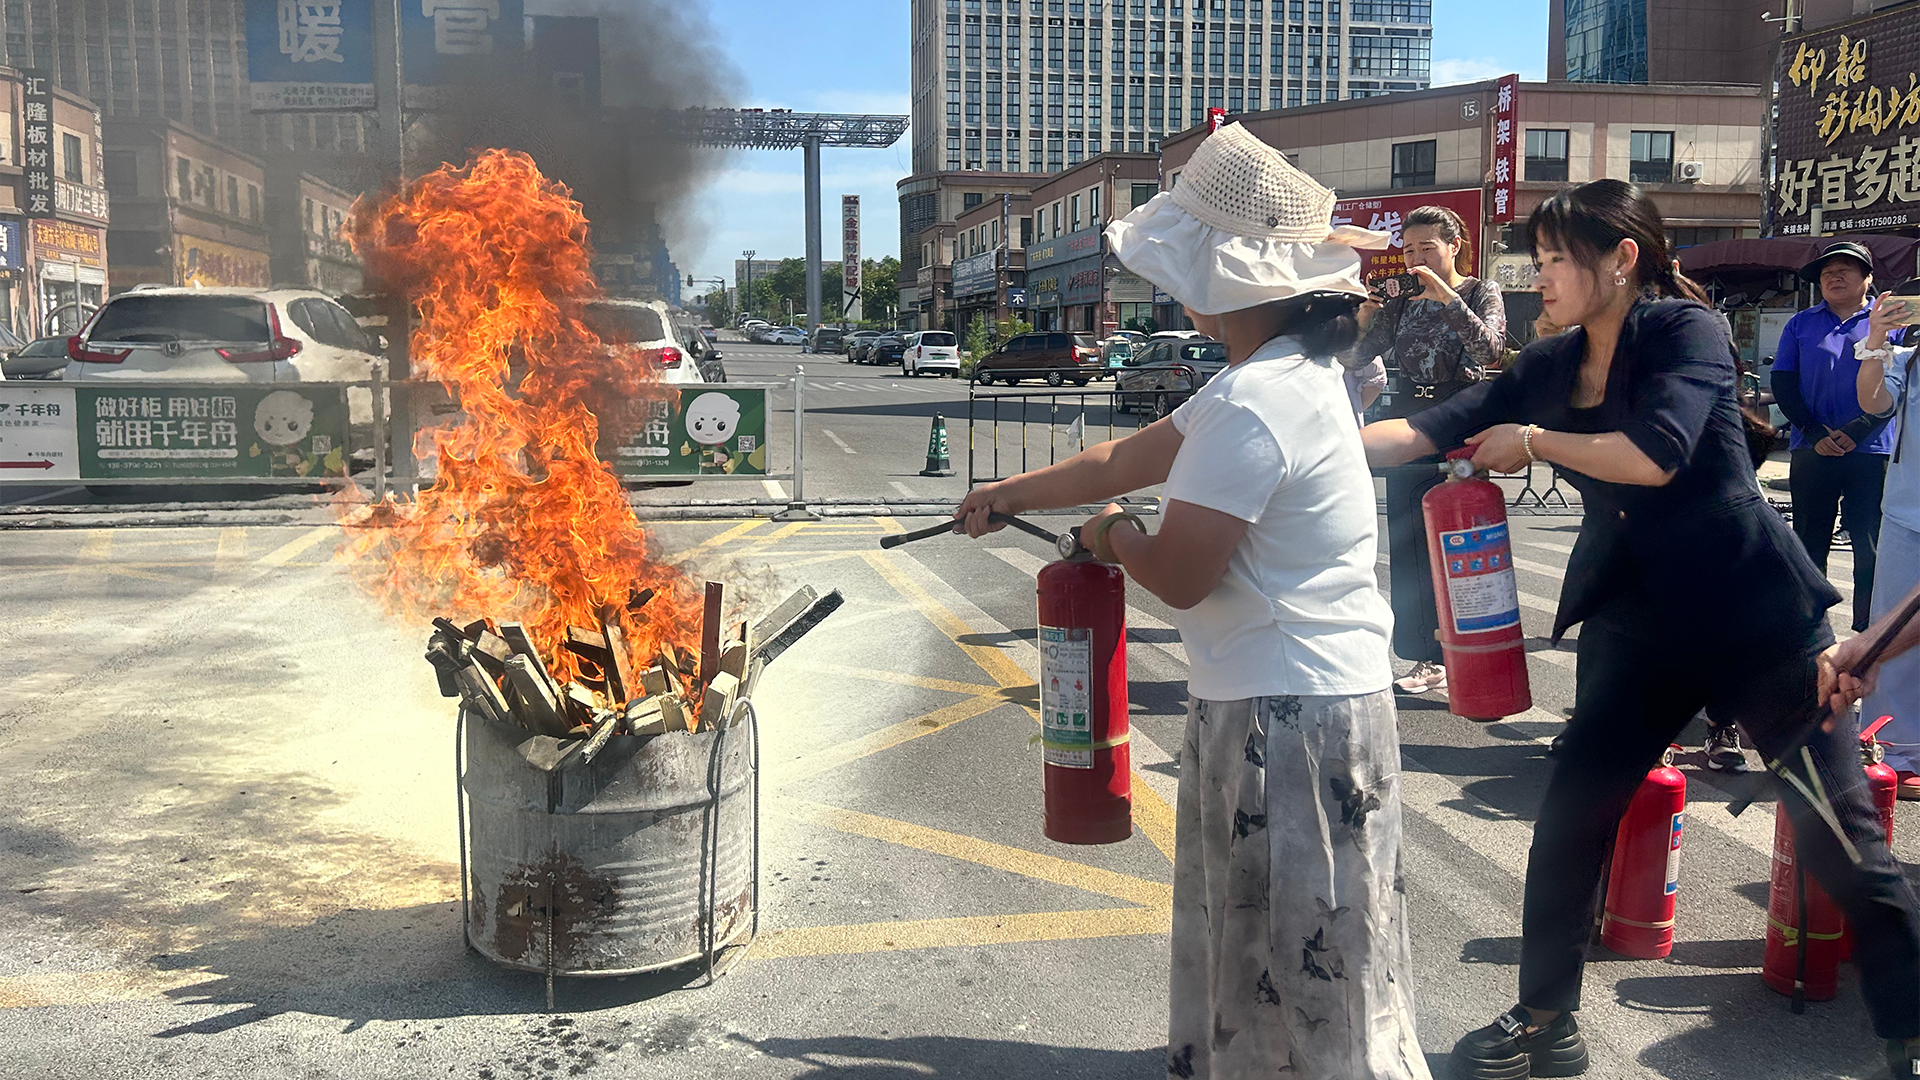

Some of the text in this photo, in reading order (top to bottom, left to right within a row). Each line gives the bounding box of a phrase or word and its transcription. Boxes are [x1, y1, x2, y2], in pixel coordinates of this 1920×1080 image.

[1788, 34, 1867, 98] 仰韶
[1815, 72, 1920, 147] 彩陶坊
[26, 76, 50, 213] 汇隆板材批发
[1494, 84, 1512, 215] 桥架铁管
[1778, 135, 1920, 217] 好宜多超
[1331, 211, 1404, 248] 线
[1333, 201, 1381, 212] 商(工厂仓储型)
[1782, 221, 1837, 234] 承接各种用酒
[844, 206, 858, 288] 五金建材汽配城
[15, 404, 61, 416] 千年舟
[95, 396, 237, 419] 做好柜 用好板
[96, 420, 238, 447] 就用千年舟
